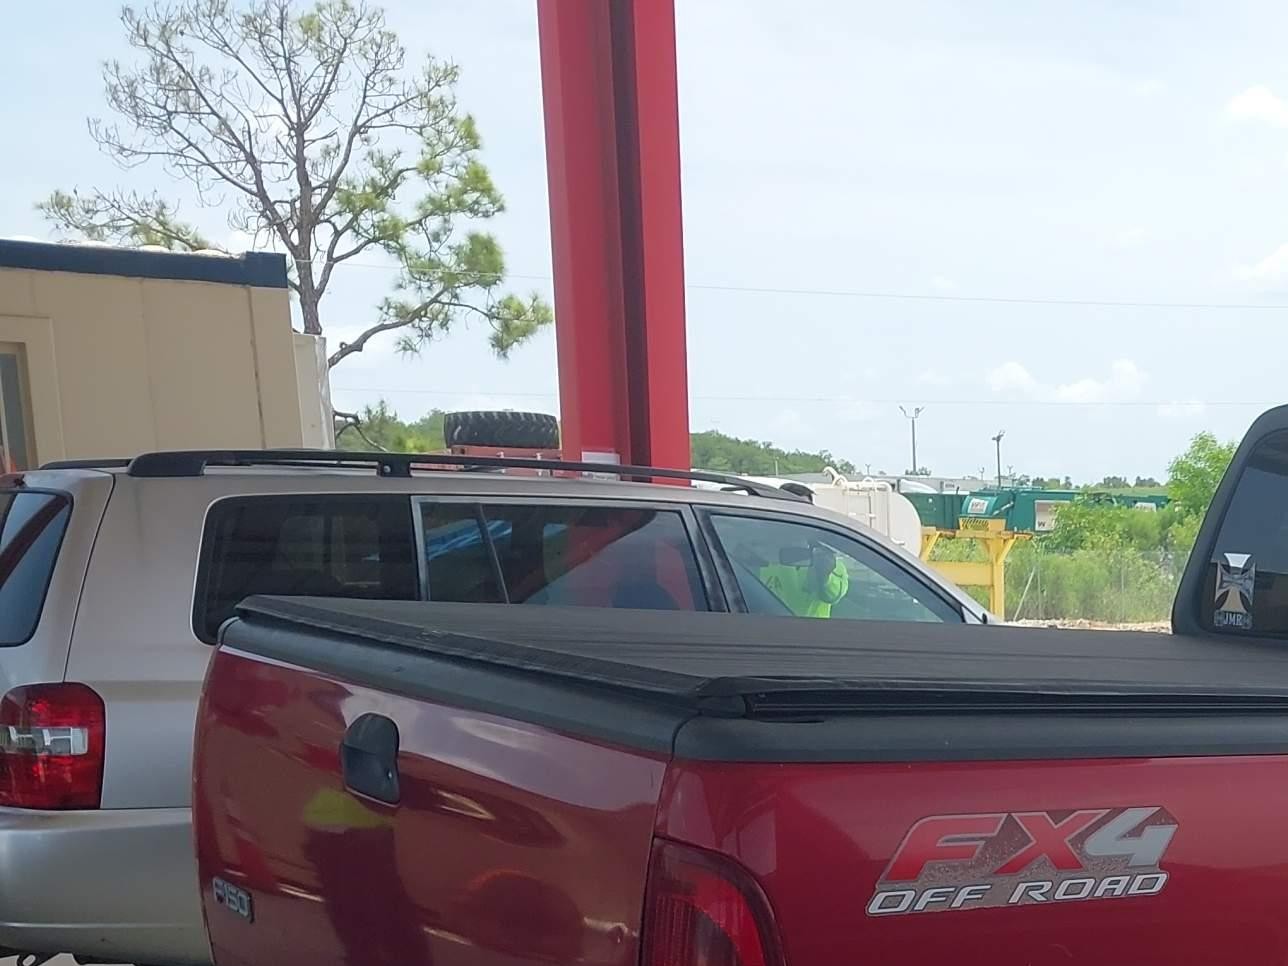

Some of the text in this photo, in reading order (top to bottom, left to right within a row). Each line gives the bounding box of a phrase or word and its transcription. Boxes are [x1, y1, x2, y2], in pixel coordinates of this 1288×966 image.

[883, 806, 1179, 881] FX4
[868, 872, 1168, 914] OFF ROAD
